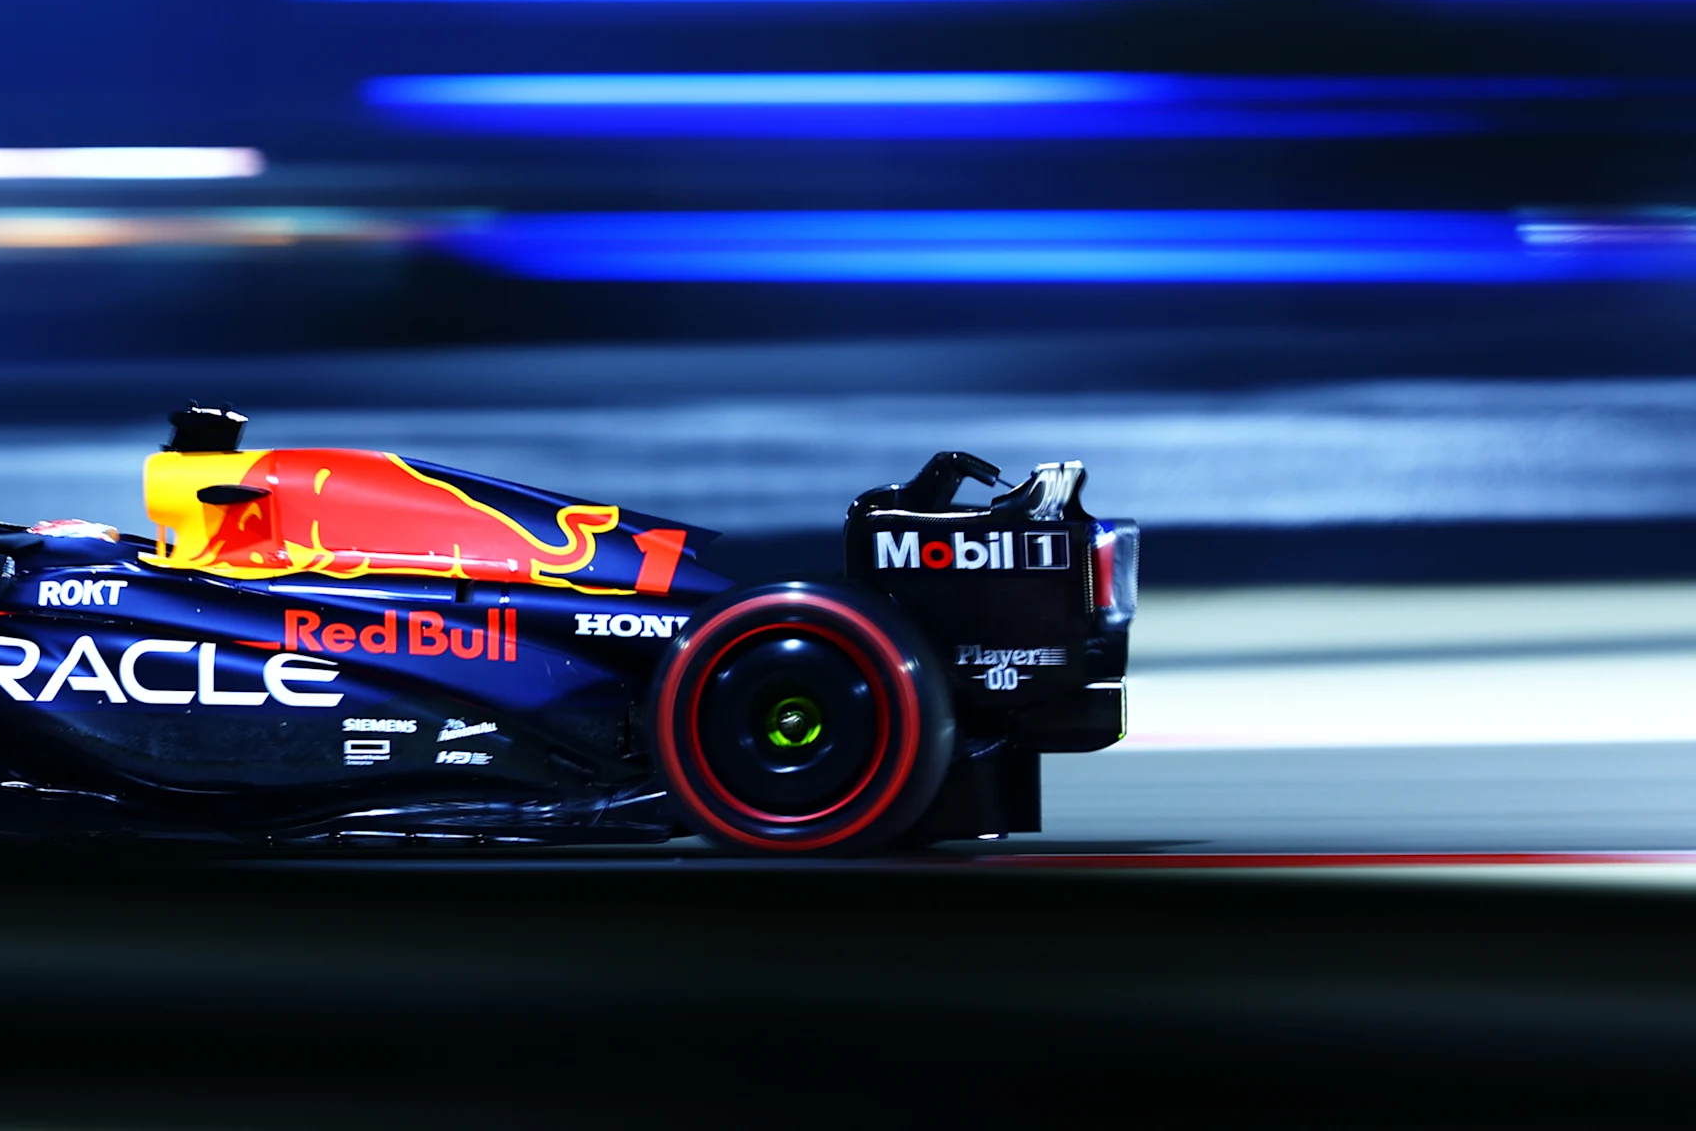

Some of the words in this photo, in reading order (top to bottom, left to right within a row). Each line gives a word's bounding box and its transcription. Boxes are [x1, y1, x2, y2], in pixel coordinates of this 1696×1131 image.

[632, 528, 688, 593] 1
[874, 530, 1015, 570] Mobil
[37, 578, 129, 607] ROKT
[284, 608, 397, 654] Red
[408, 607, 517, 662] Bull
[342, 717, 418, 734] SIEMENS
